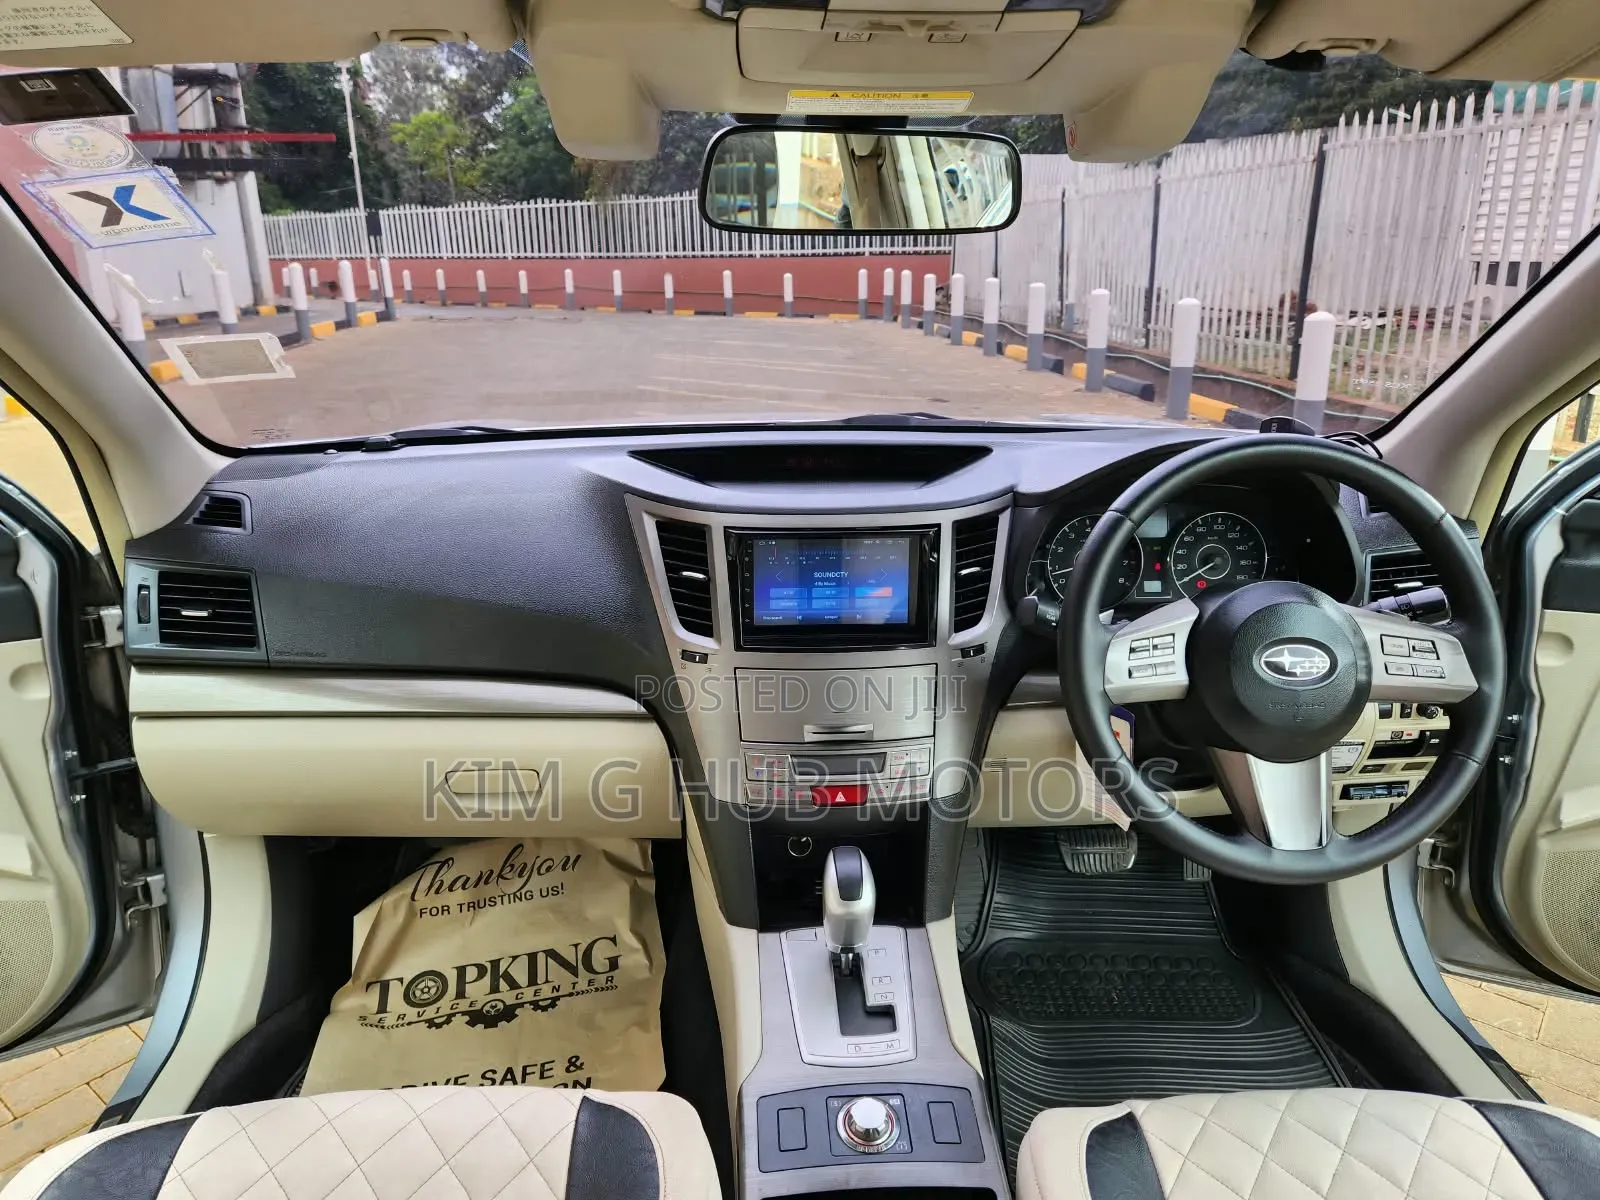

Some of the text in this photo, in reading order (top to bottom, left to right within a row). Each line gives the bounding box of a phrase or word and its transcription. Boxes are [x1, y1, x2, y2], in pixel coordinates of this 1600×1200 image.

[419, 882, 565, 919] FOR TRUSTING US!
[365, 934, 623, 1015] TOPKING
[357, 975, 617, 1024] SERVICE CENTER
[479, 1060, 556, 1086] SAFE
[564, 1055, 585, 1074] &
